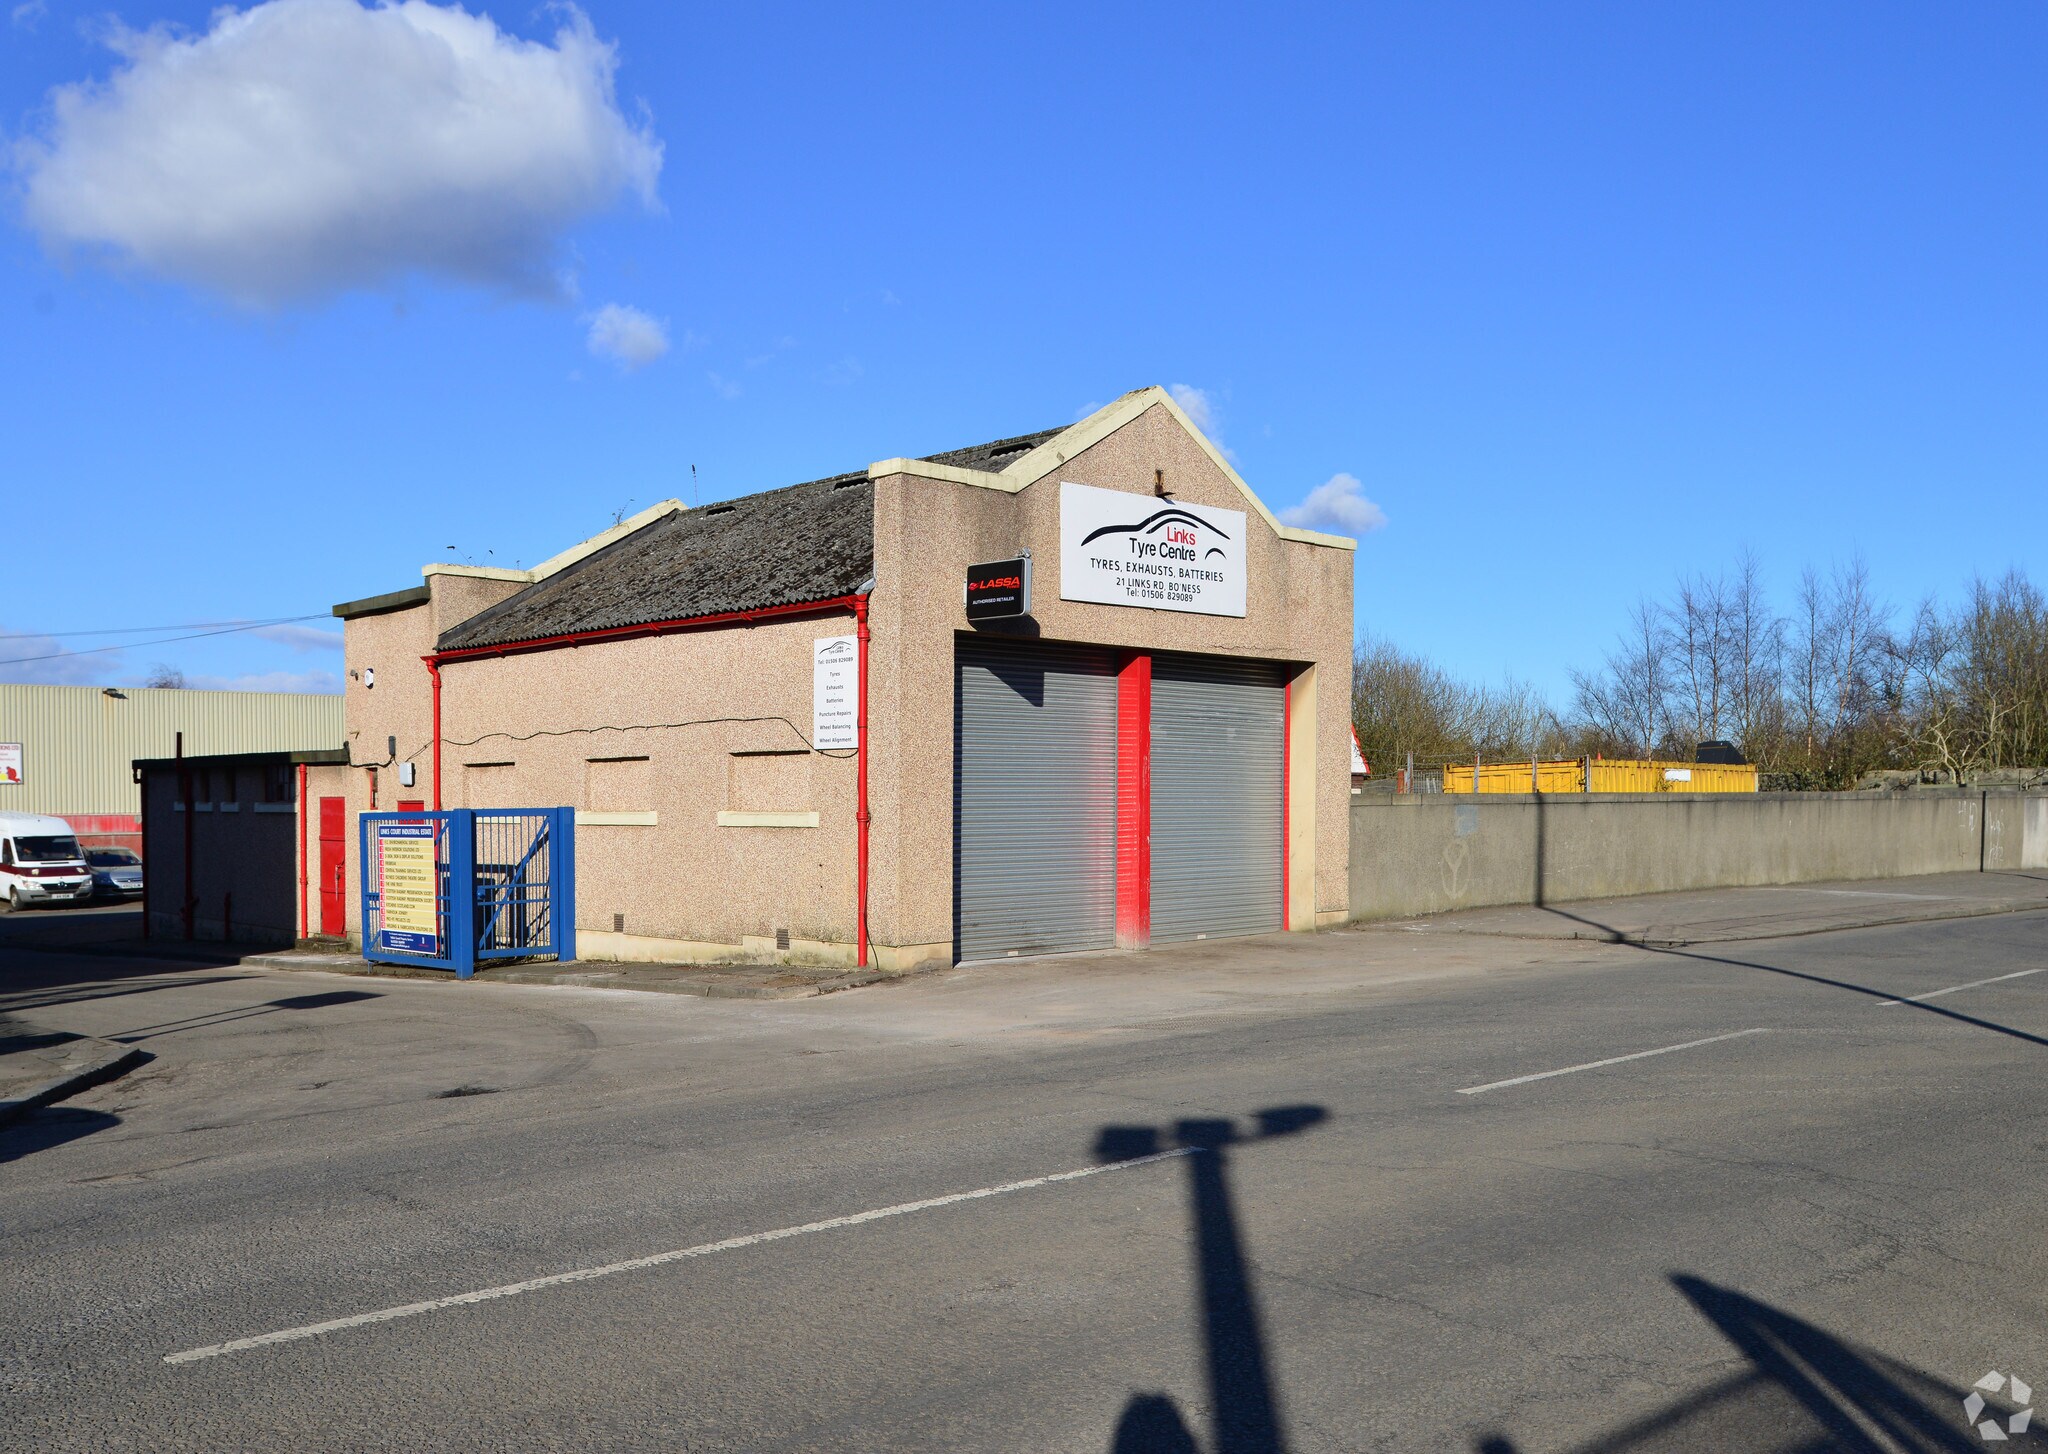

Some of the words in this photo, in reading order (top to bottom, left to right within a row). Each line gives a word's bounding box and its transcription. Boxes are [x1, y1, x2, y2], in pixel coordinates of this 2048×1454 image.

[1166, 525, 1196, 546] Links
[1129, 537, 1156, 559] Tyre
[1159, 541, 1196, 562] Centre
[1090, 558, 1123, 572] TYRES,
[1126, 562, 1176, 578] EXHAUSTS,
[1178, 568, 1224, 583] BATTERIES
[980, 576, 1020, 590] LASSA
[1116, 577, 1126, 586] 21
[1128, 578, 1151, 589] LINKS
[1168, 582, 1202, 594] BO'NESS
[1126, 587, 1140, 598] Tel:
[1141, 589, 1164, 600] 01506
[1167, 591, 1194, 602] 829089
